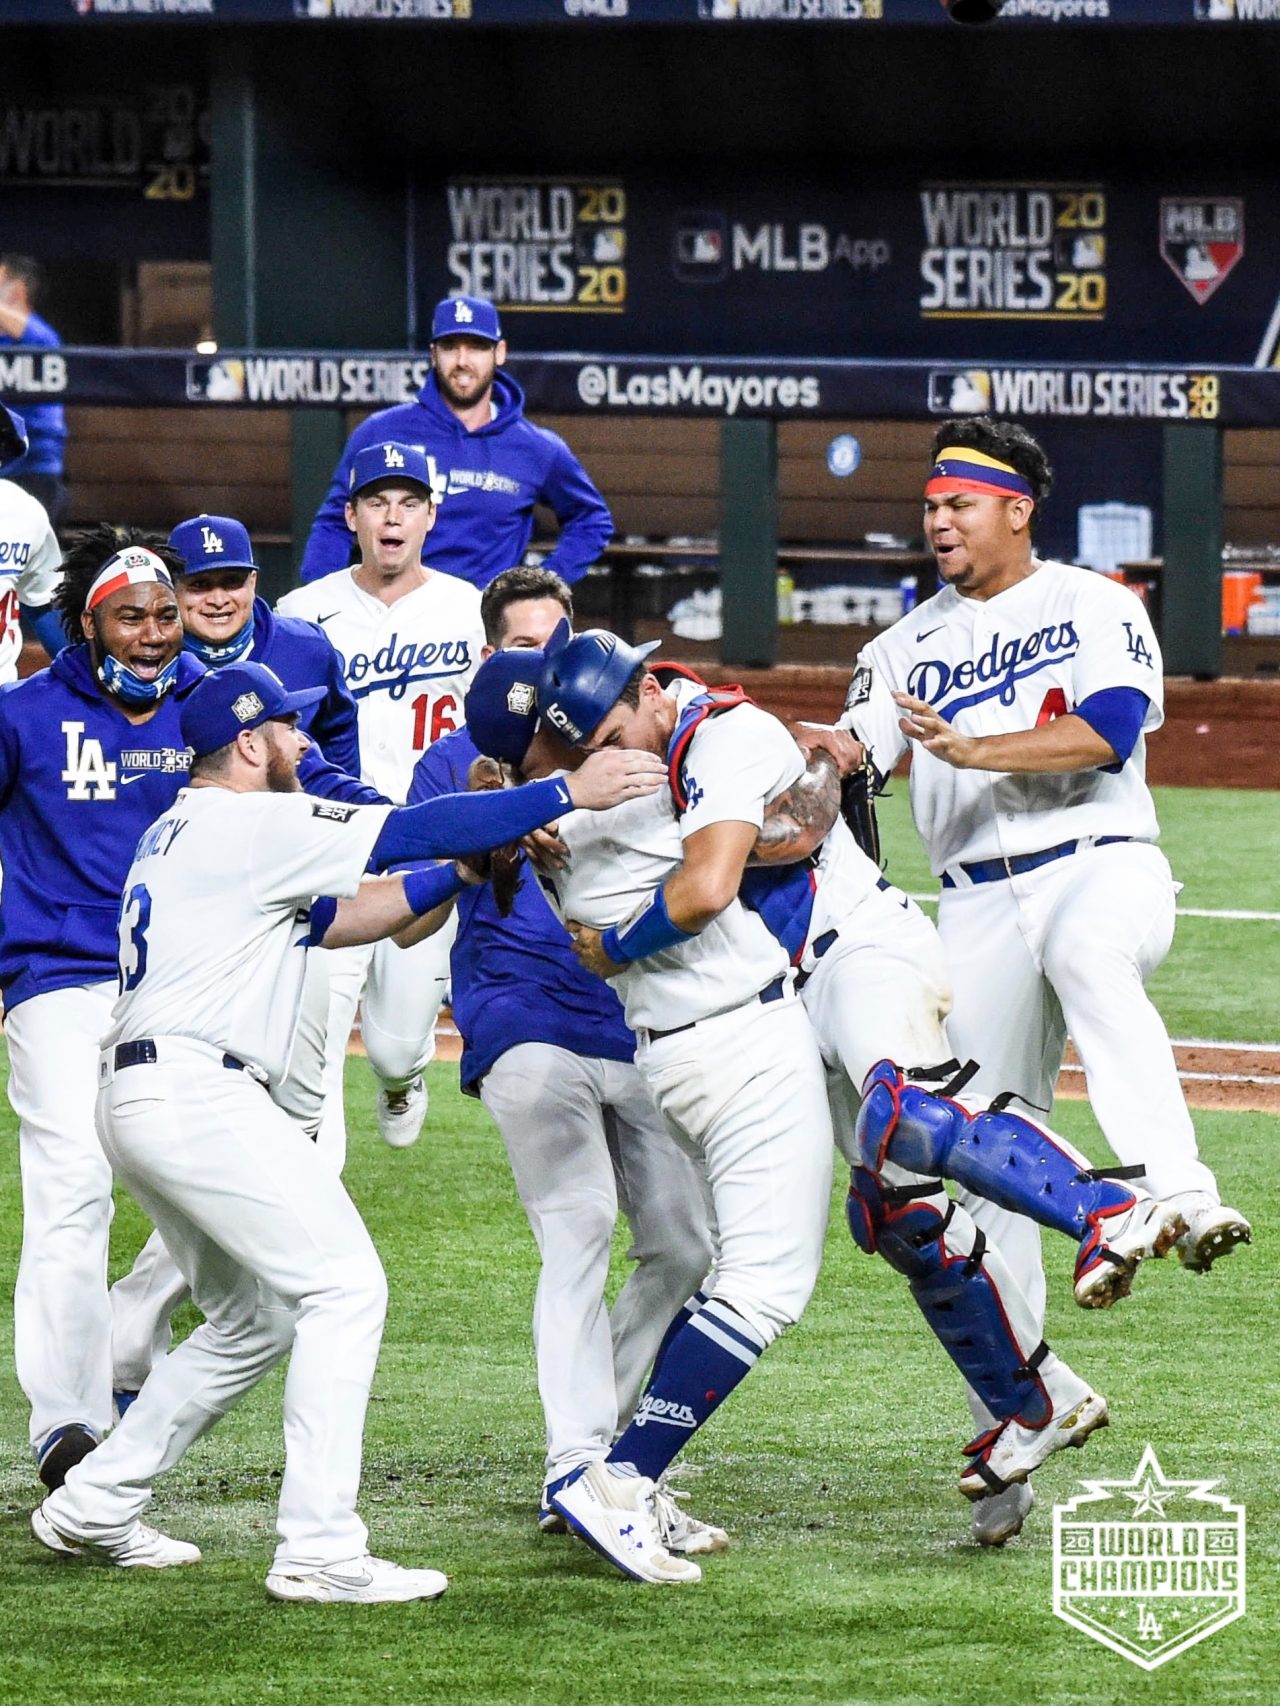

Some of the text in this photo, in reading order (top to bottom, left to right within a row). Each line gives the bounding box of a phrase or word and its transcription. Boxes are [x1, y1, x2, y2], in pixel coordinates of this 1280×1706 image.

[448, 186, 574, 240] WORLD
[578, 188, 626, 223] 20
[921, 192, 1053, 247] WORLD
[1055, 194, 1105, 228] 20
[1168, 206, 1236, 231] MLB
[732, 225, 892, 271] MLB App
[448, 243, 574, 301] SERIES
[578, 266, 626, 303] 20
[921, 249, 1053, 310] SERIES
[1055, 273, 1106, 311] 20
[245, 358, 339, 401] WORLD
[577, 365, 819, 415] @LasMayores
[991, 370, 1188, 418] WORLD SERIES
[383, 444, 405, 468] LA
[201, 526, 224, 553] LA
[334, 633, 472, 701] odgers
[907, 620, 1080, 707] Dodgers
[1122, 622, 1154, 669] LA
[411, 694, 457, 751] 16
[61, 721, 117, 800] LA
[121, 752, 161, 768] WORLD
[118, 883, 153, 998] 3
[634, 1388, 697, 1427] gers
